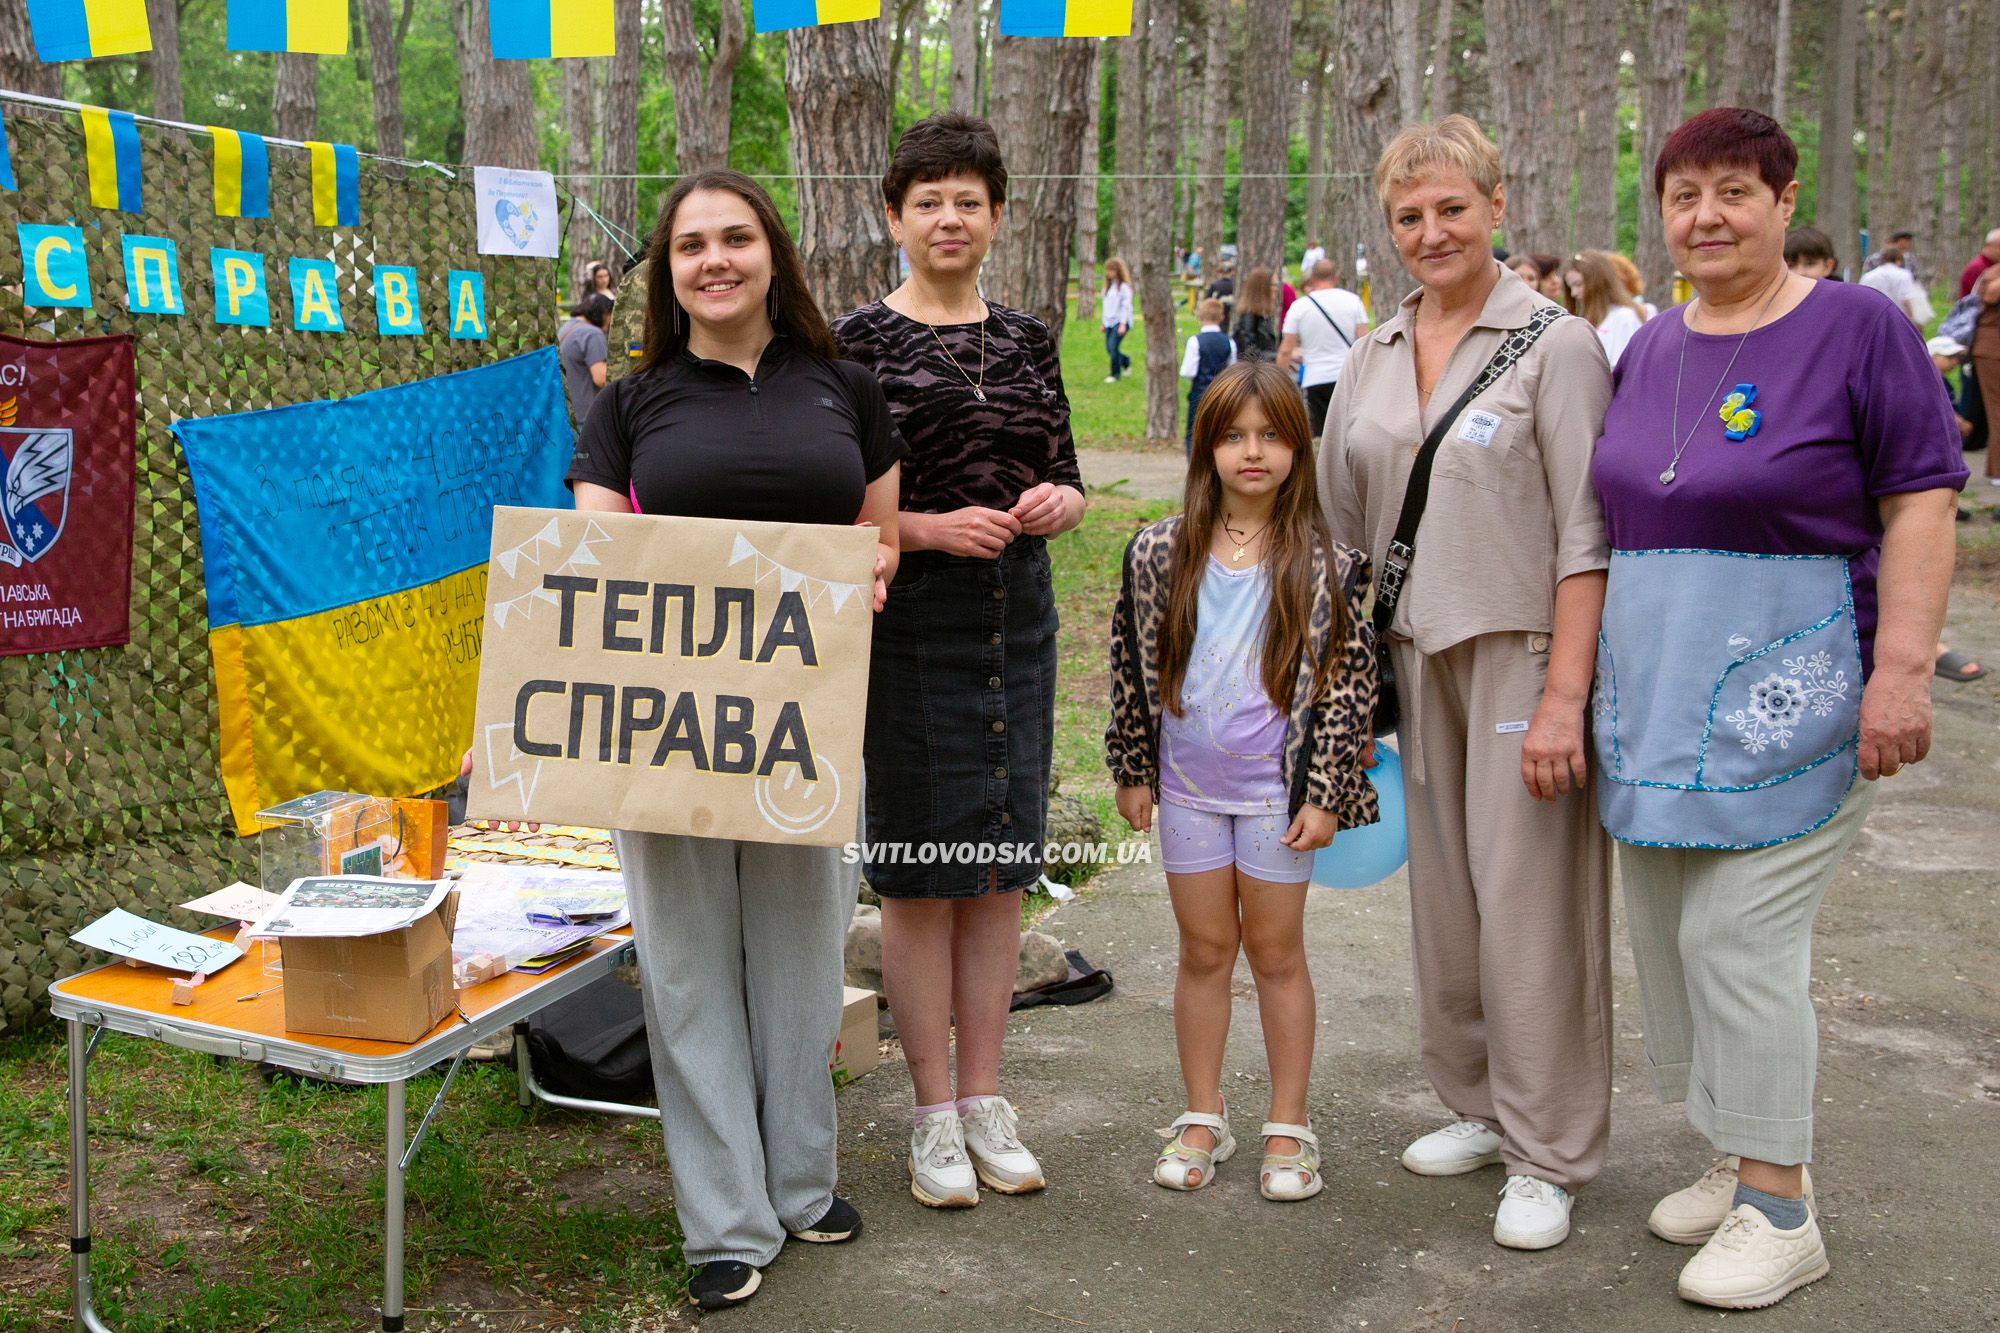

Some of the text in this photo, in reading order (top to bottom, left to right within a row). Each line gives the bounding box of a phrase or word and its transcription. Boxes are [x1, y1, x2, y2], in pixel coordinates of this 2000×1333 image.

[34, 236, 483, 333] СПРАВА
[0, 363, 26, 387] С!
[0, 610, 26, 629] НА
[333, 600, 400, 650] РАЗОМ
[542, 573, 822, 670] ТЕПЛА
[512, 679, 822, 784] СПРАВА
